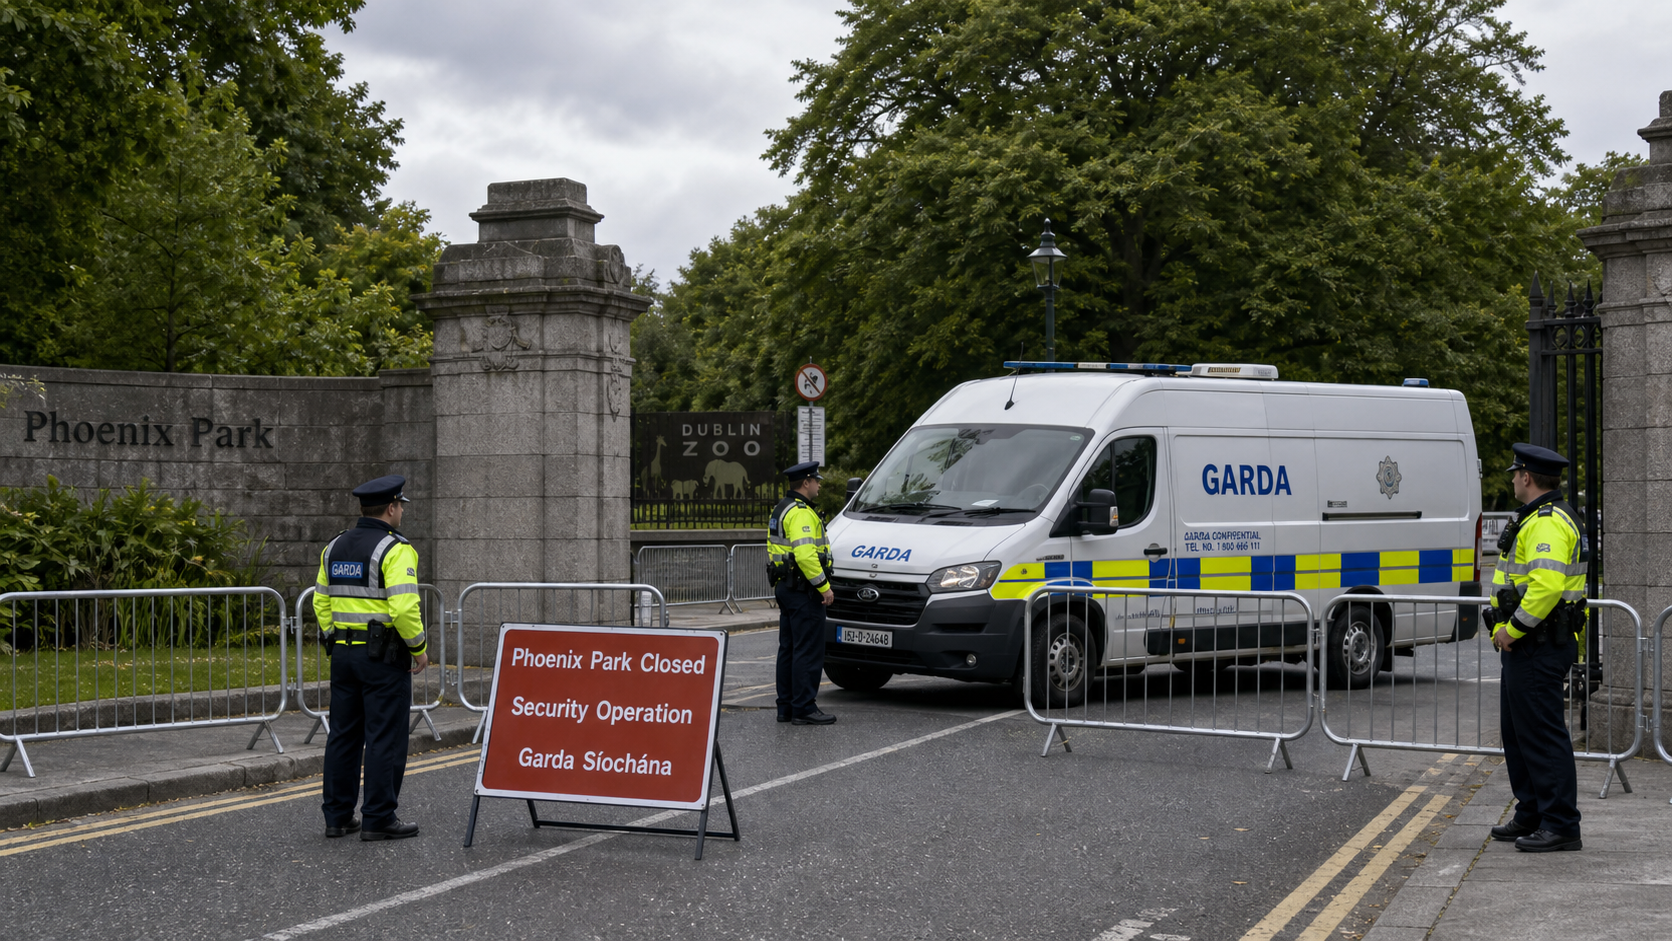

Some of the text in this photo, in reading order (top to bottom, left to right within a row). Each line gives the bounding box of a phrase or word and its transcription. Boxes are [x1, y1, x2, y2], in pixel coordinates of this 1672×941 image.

[23, 410, 274, 449] Phoenix Park
[682, 423, 761, 437] DUBLIN
[682, 440, 761, 457] ZOO
[1202, 463, 1292, 496] GARDA
[851, 545, 912, 562] GARDA
[332, 563, 362, 577] GARDA
[511, 647, 706, 675] Phoenix Park Closed
[511, 696, 693, 725] Security Operation
[518, 747, 672, 776] Garda Síochána
